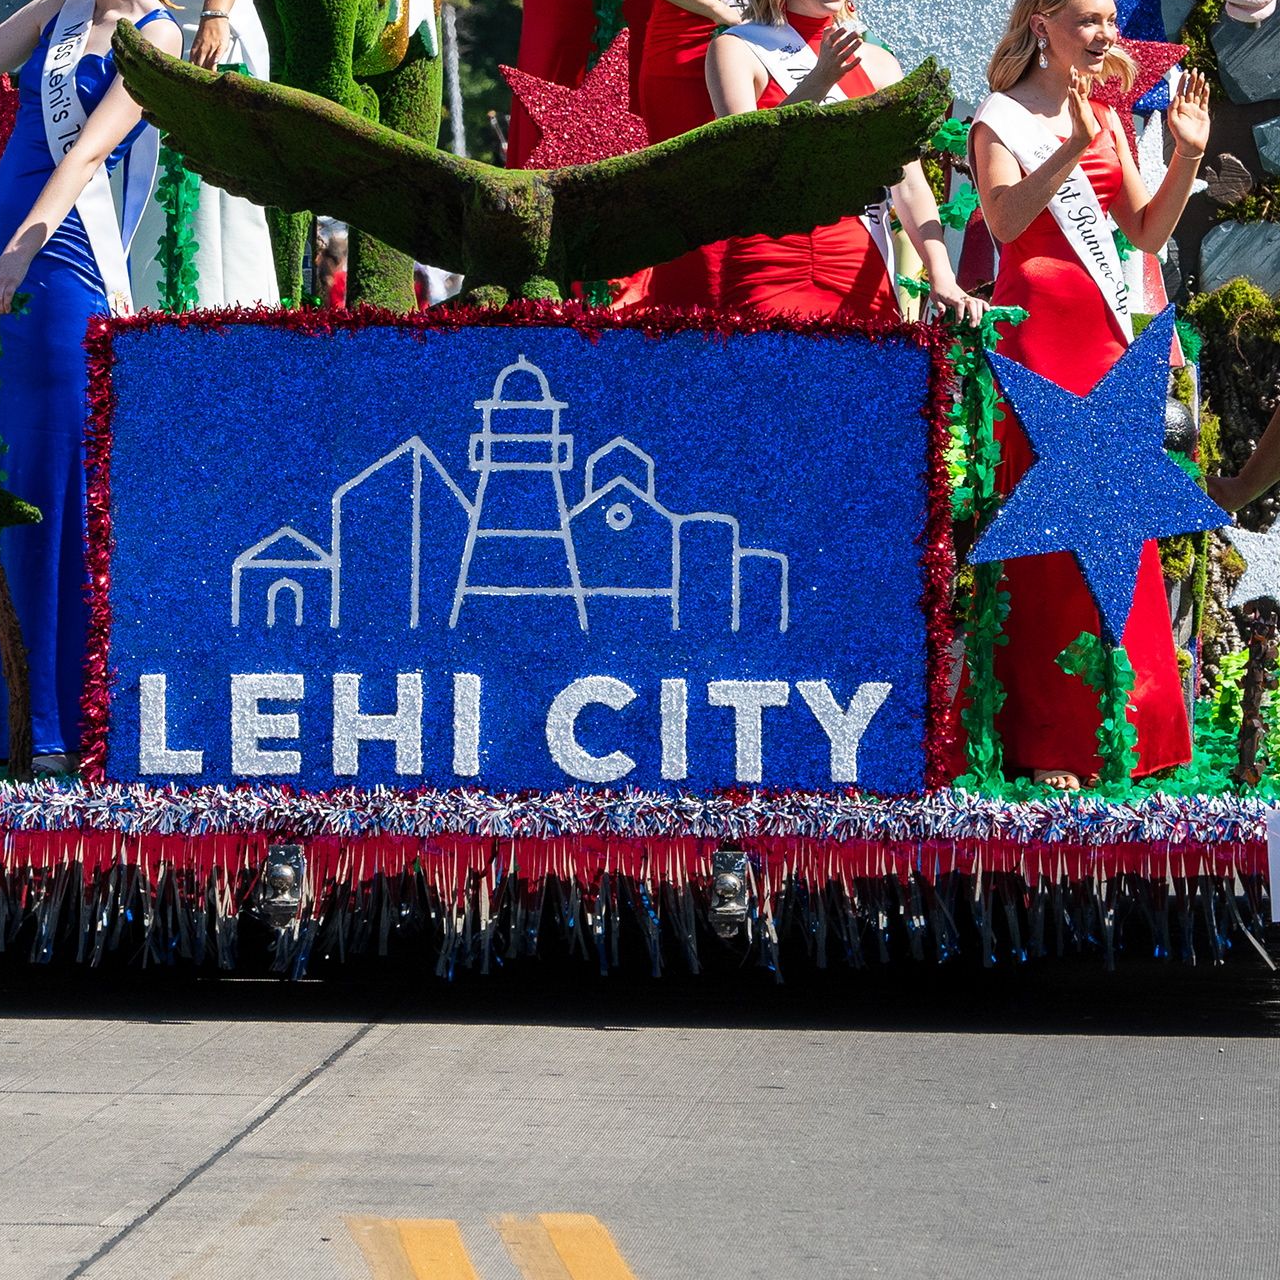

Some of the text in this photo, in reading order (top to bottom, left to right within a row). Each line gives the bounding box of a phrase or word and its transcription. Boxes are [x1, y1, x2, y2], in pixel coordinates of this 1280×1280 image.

[54, 20, 85, 61] Miss
[48, 62, 72, 124] Lehi's
[1067, 205, 1128, 316] Runner-Up
[138, 672, 894, 783] LEHI CITY
